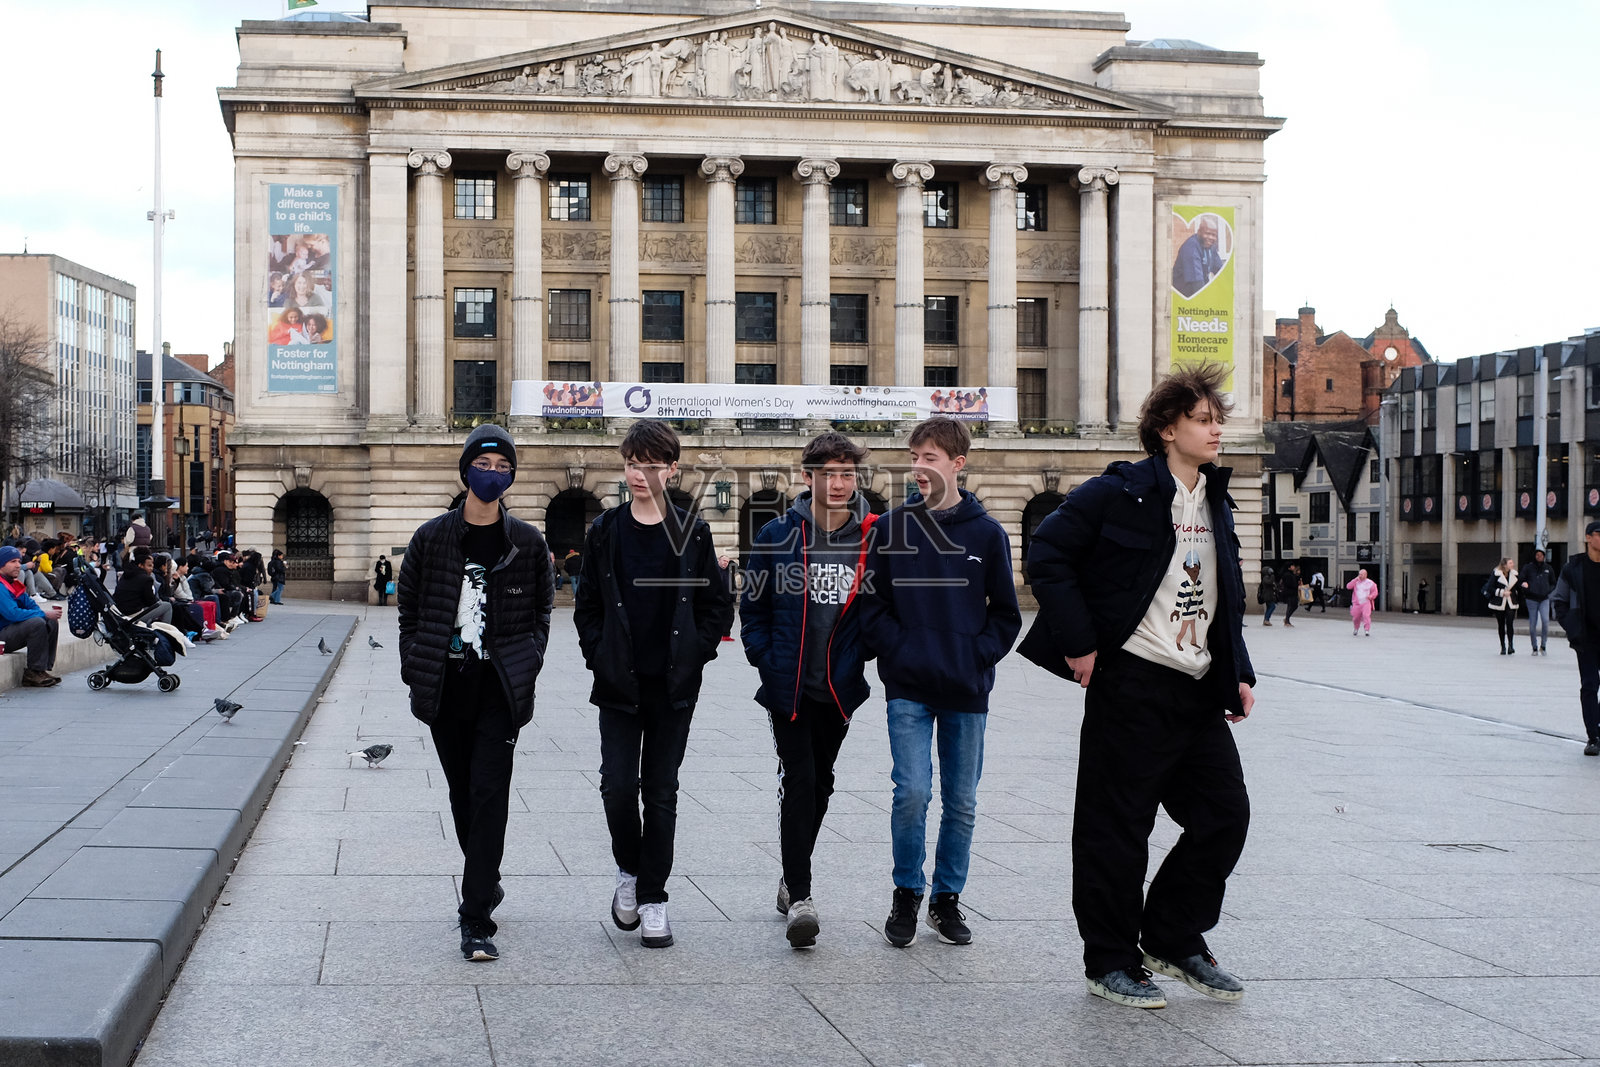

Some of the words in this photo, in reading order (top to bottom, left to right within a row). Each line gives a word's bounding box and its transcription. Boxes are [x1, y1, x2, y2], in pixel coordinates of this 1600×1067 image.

[284, 187, 314, 198] Make
[316, 190, 323, 198] a
[277, 199, 330, 209] difference
[275, 211, 287, 221] to
[289, 213, 296, 221] a
[298, 211, 332, 221] child's
[294, 222, 313, 233] life.
[1177, 307, 1228, 317] Nottingham
[1177, 316, 1229, 333] Needs
[1177, 334, 1229, 344] Homecare
[276, 348, 311, 359] Foster
[312, 349, 329, 359] for
[1177, 344, 1219, 353] workers
[271, 359, 334, 373] Nottingham
[658, 395, 721, 407] International
[724, 397, 772, 408] Women's
[774, 397, 795, 411] Day
[806, 397, 917, 408] www.iwdnottingham.com
[542, 406, 603, 416] #iwdnottingham
[657, 406, 675, 417] 8th
[677, 406, 712, 417] March
[810, 563, 838, 577] THE
[810, 576, 838, 591] RTH
[810, 590, 839, 605] ACE
